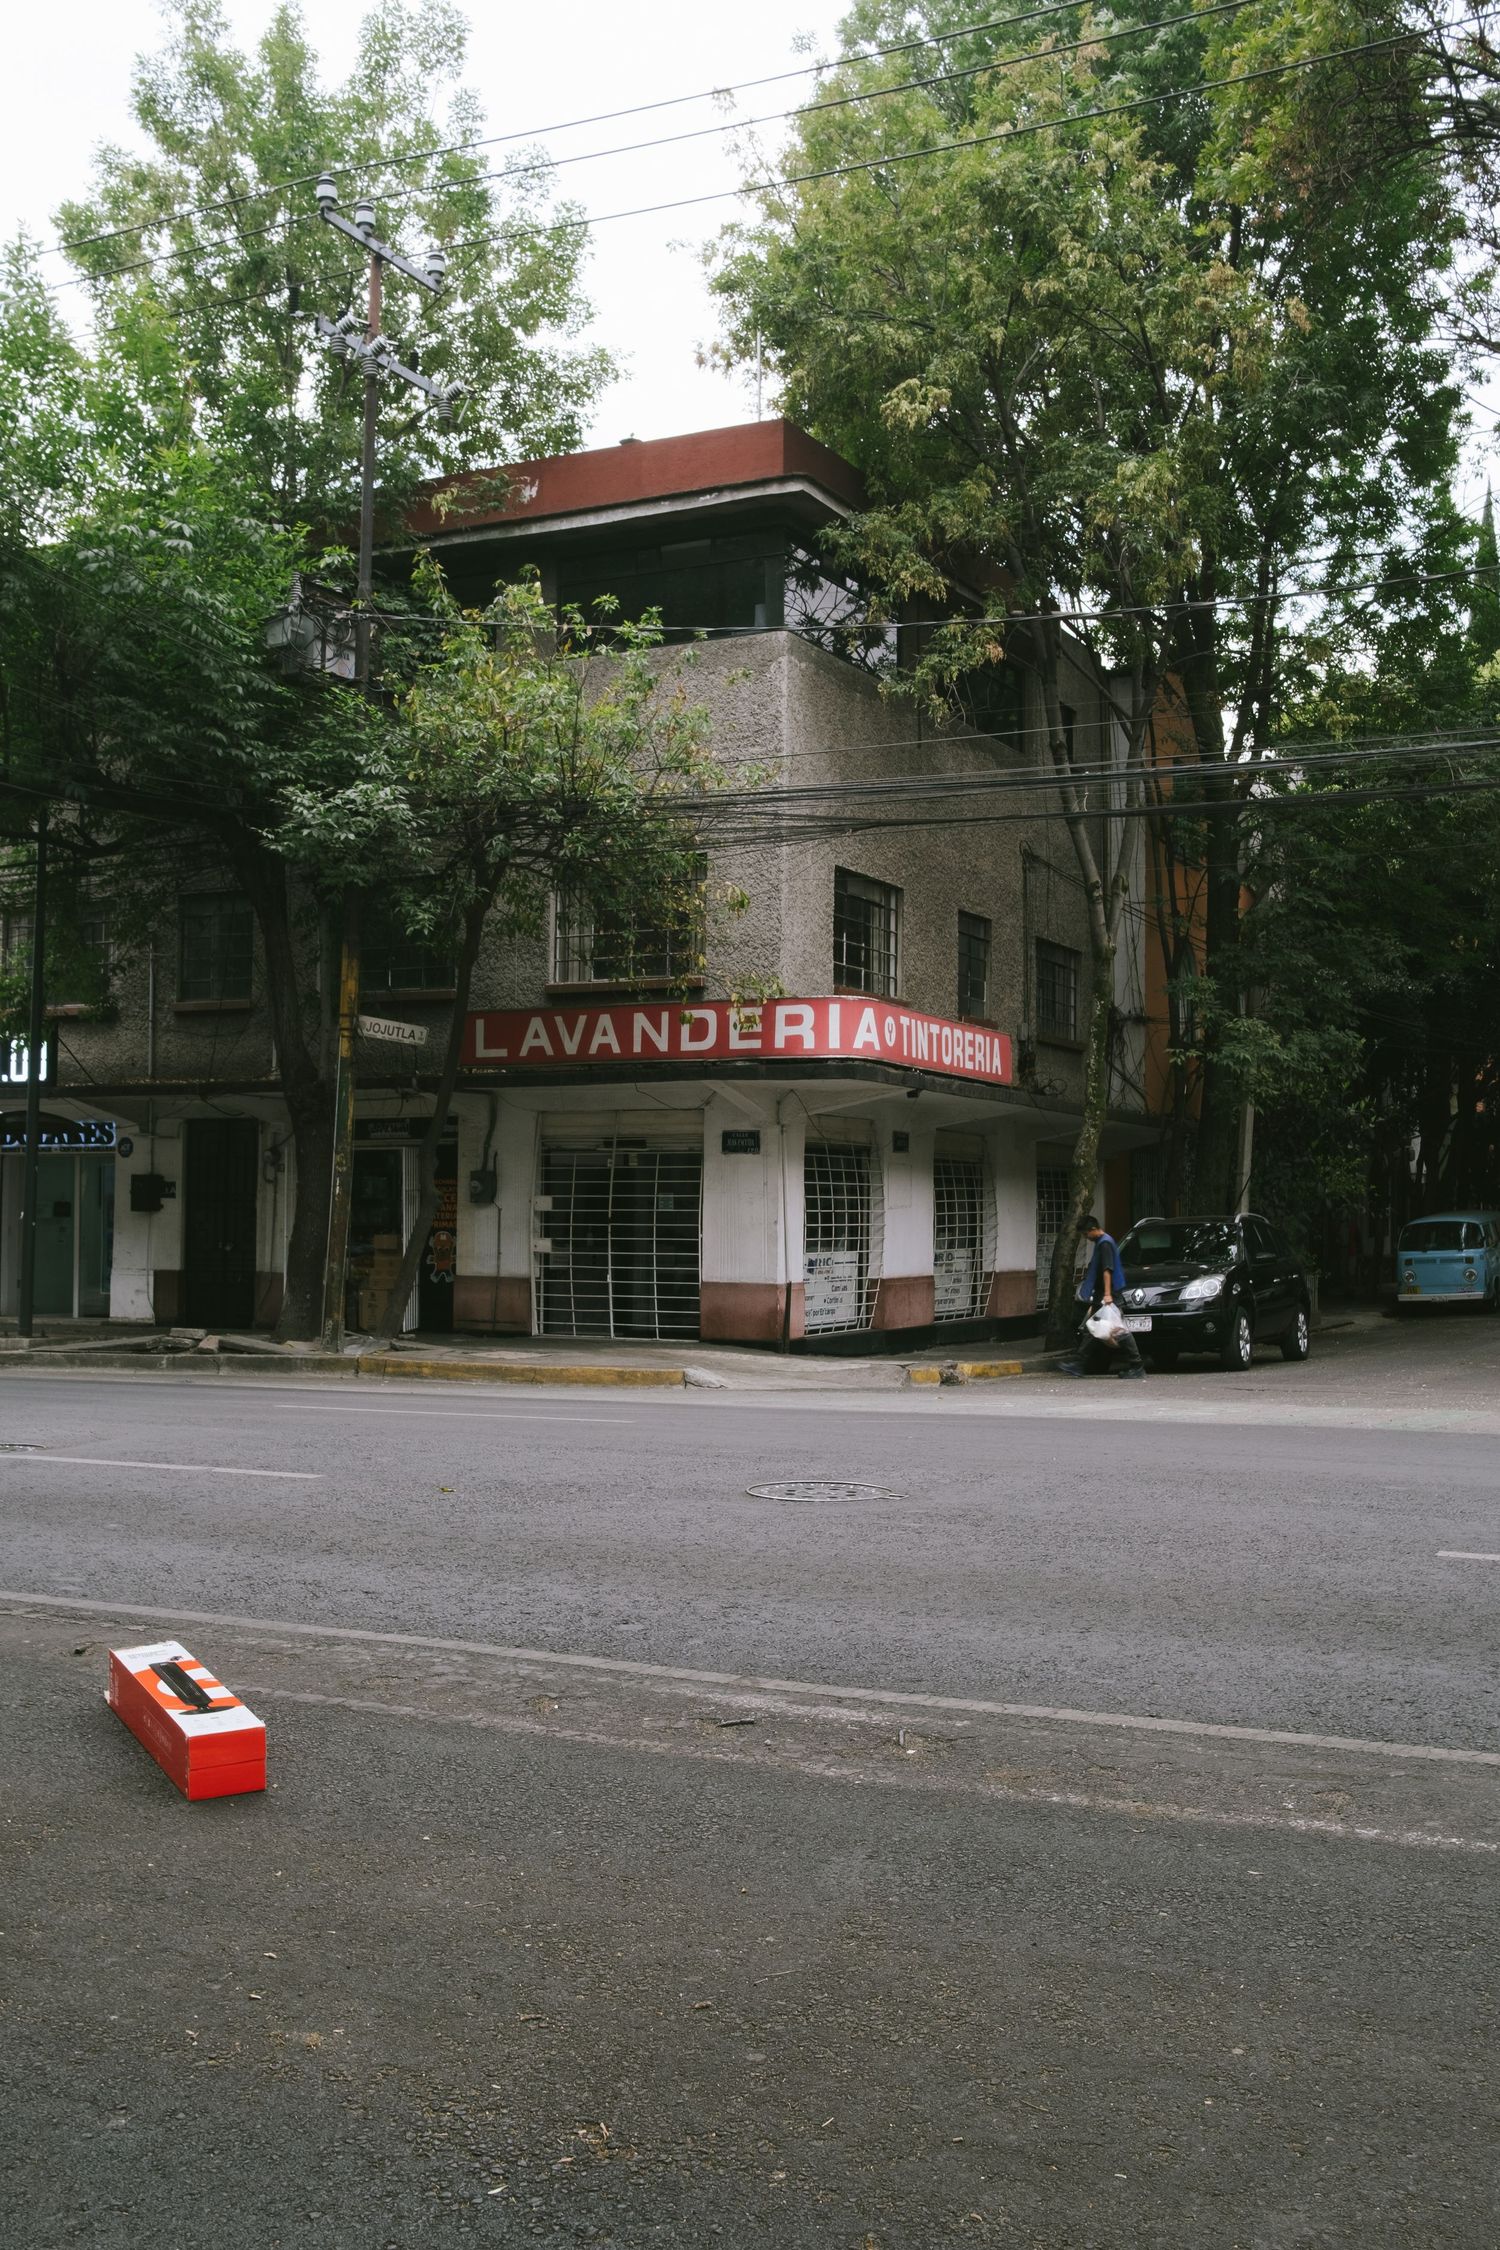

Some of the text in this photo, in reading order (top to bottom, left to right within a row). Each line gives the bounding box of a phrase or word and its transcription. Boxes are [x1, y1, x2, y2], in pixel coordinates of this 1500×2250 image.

[366, 1022, 416, 1040] JOJUTLA
[475, 1004, 881, 1058] LAVANDERIA
[900, 1016, 1002, 1075] TINTORERIA
